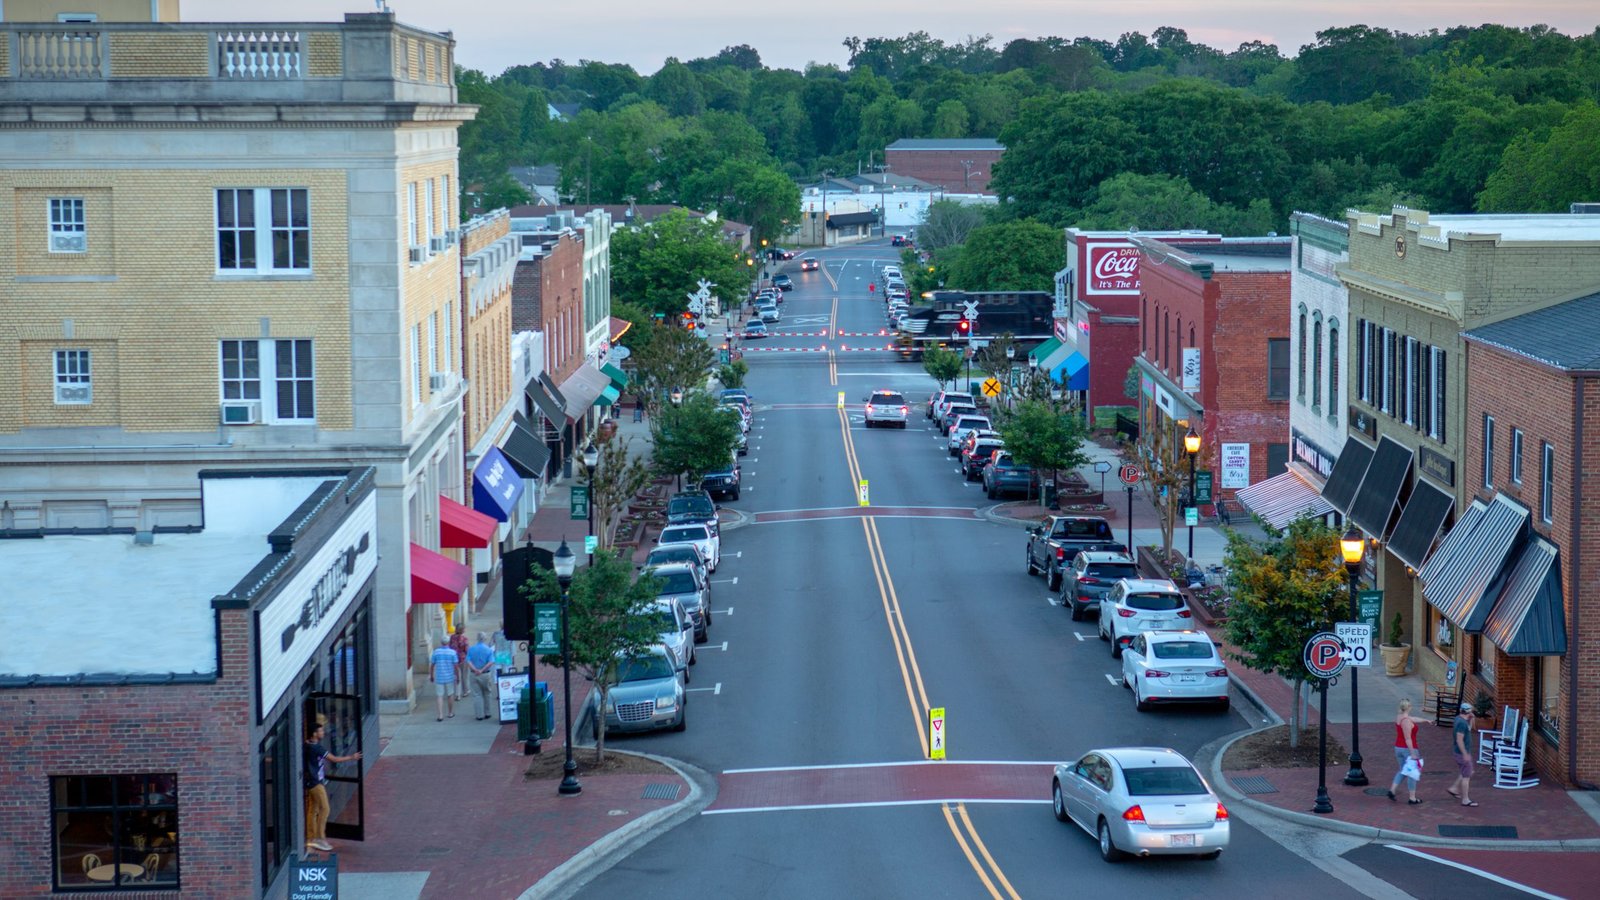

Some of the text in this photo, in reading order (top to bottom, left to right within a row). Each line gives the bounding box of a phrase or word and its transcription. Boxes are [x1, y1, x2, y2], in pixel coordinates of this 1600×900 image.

[1099, 280, 1113, 288] It's
[1116, 280, 1131, 289] The
[1126, 468, 1137, 480] P
[1338, 628, 1369, 636] SPEED
[1319, 644, 1338, 665] P
[299, 867, 328, 881] NSK
[307, 892, 333, 900] Friendly
